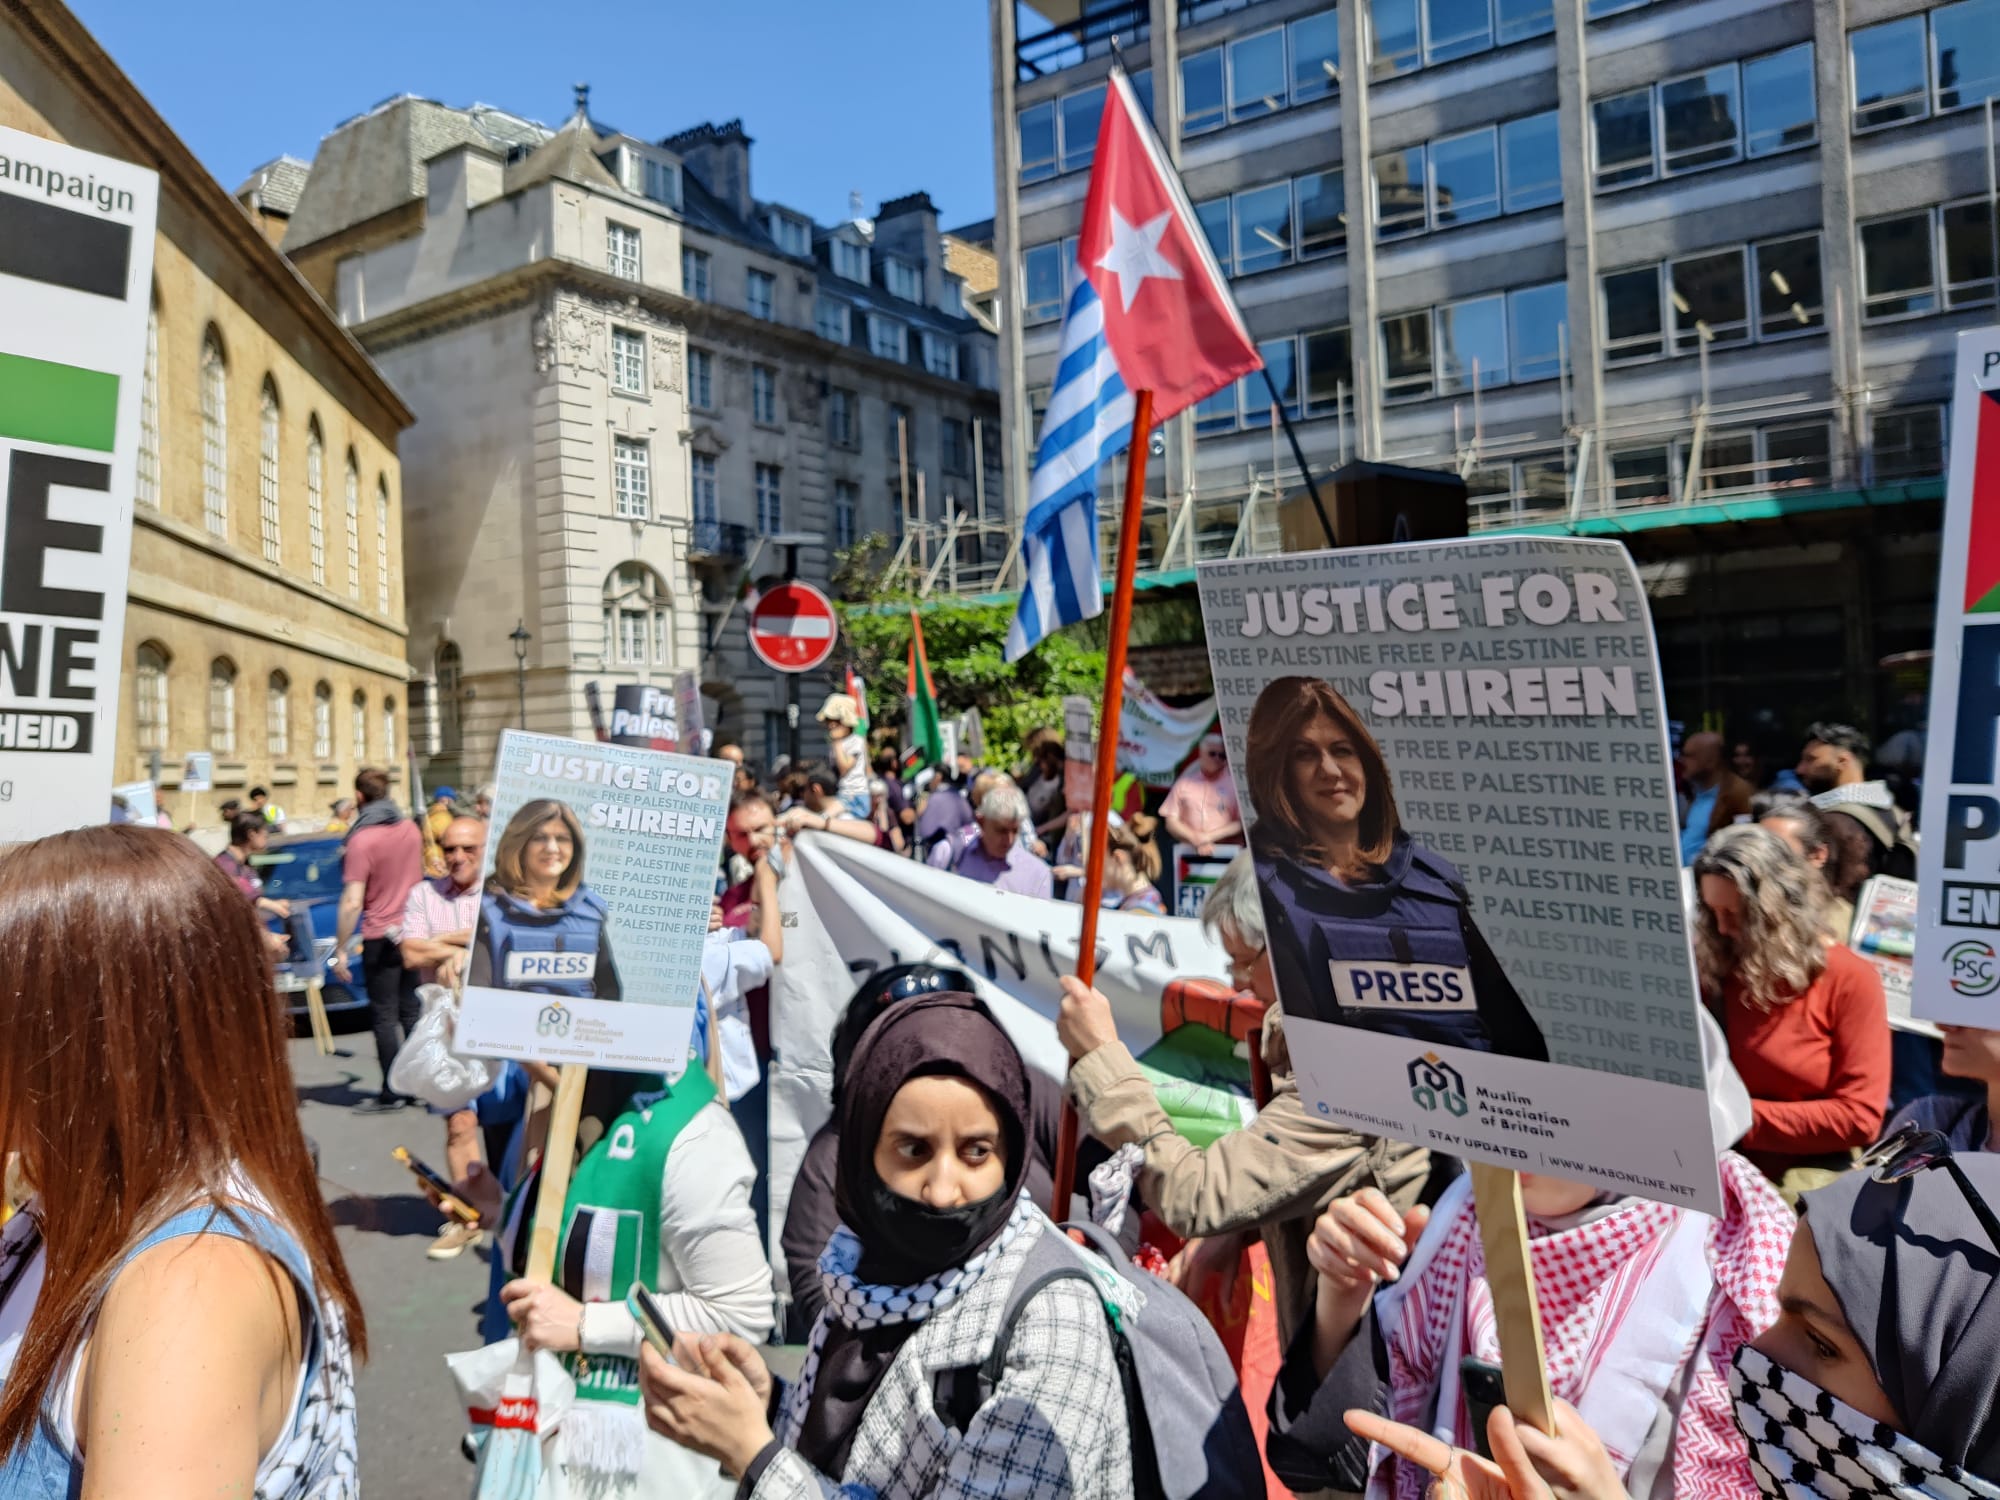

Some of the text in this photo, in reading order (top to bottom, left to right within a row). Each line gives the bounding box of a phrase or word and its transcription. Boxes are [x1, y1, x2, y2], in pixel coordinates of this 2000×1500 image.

[1241, 581, 1460, 638] JUSTICE
[1481, 572, 1627, 627] FOR
[1258, 645, 1374, 666] PALESTINE
[1377, 643, 1436, 665] FREE
[1442, 637, 1588, 662] PALESTINE
[1368, 666, 1638, 718] SHIREEN
[1394, 739, 1452, 760] FREE
[1456, 740, 1601, 763] PALESTINE
[524, 752, 650, 791] JUSTICE
[659, 769, 722, 801] FOR
[1399, 770, 1456, 791] FREE
[1463, 772, 1607, 797] PALESTINE
[601, 789, 631, 804] FREE
[634, 795, 702, 813] PALESTINE
[1404, 800, 1460, 823] FREE
[1468, 803, 1612, 830] PALESTINE
[588, 803, 717, 840] SHIREEN
[627, 840, 693, 858] PALESTINE
[1473, 834, 1617, 863] PALESTINE
[625, 856, 690, 873] PALESTINE
[622, 870, 688, 889] PALESTINE
[1478, 865, 1621, 895] PALESTINE
[619, 886, 685, 904] PALESTINE
[617, 901, 683, 919] PALESTINE
[1483, 895, 1625, 928] PALESTINE
[615, 917, 680, 935] PALESTINE
[1487, 925, 1629, 960] PALESTINE
[521, 956, 589, 975] PRESS
[1954, 959, 1993, 981] PSC
[1349, 968, 1464, 1003] PRESS
[1517, 987, 1638, 1023] ALESTINE
[1475, 1086, 1532, 1107] Muslim
[1478, 1101, 1571, 1129] Association
[1481, 1114, 1555, 1140] of Britain
[1428, 1128, 1462, 1146] STAY
[1464, 1138, 1529, 1161] UPDATED
[1548, 1156, 1698, 1199] WWW.MABONLINE.NET
